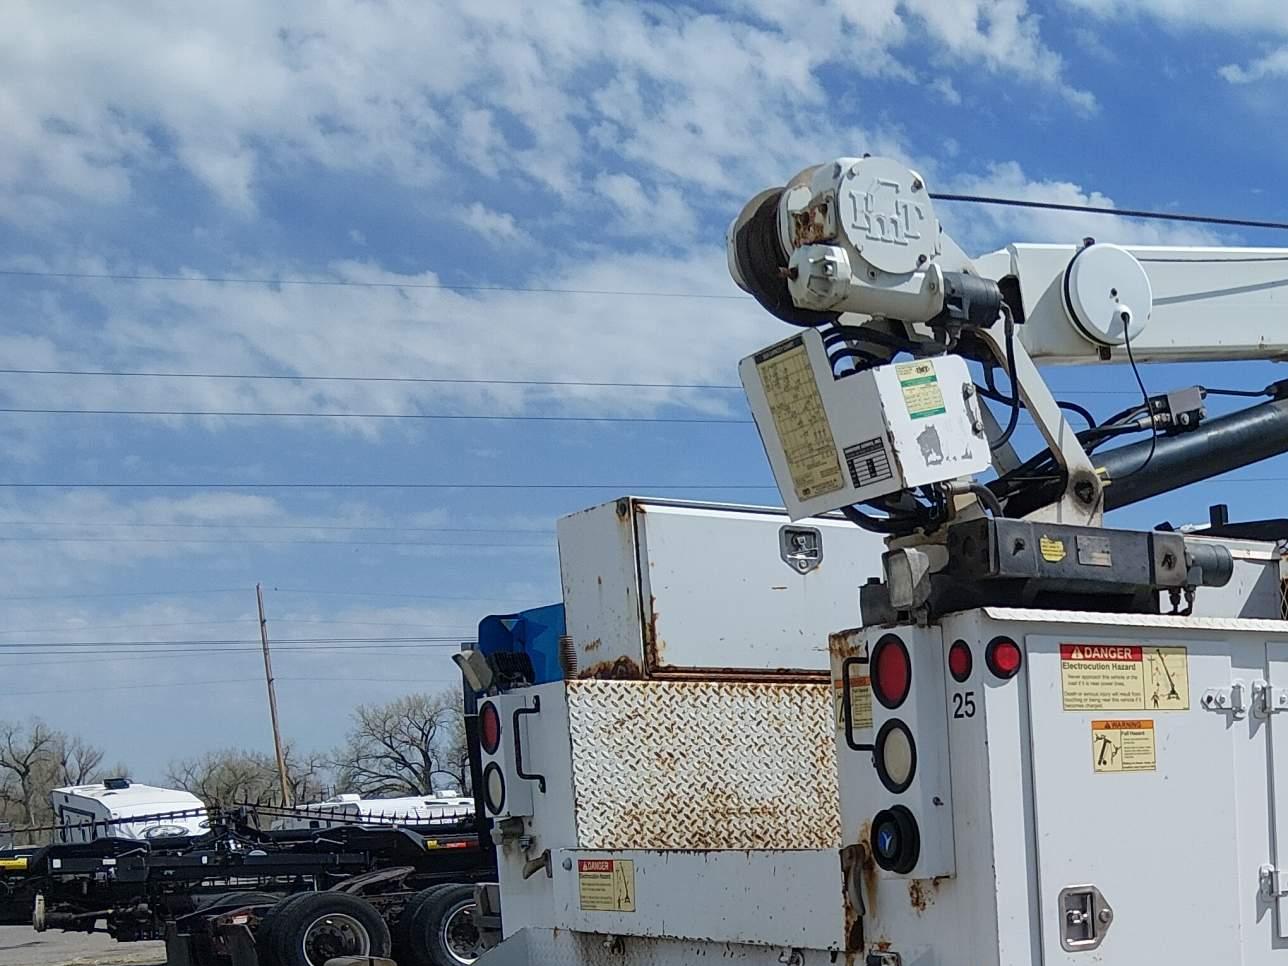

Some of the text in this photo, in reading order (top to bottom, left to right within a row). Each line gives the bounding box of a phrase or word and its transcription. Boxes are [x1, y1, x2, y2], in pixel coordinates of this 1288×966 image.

[1084, 647, 1132, 659] DANGER
[1062, 663, 1110, 671] Electrocution
[953, 692, 976, 719] 25
